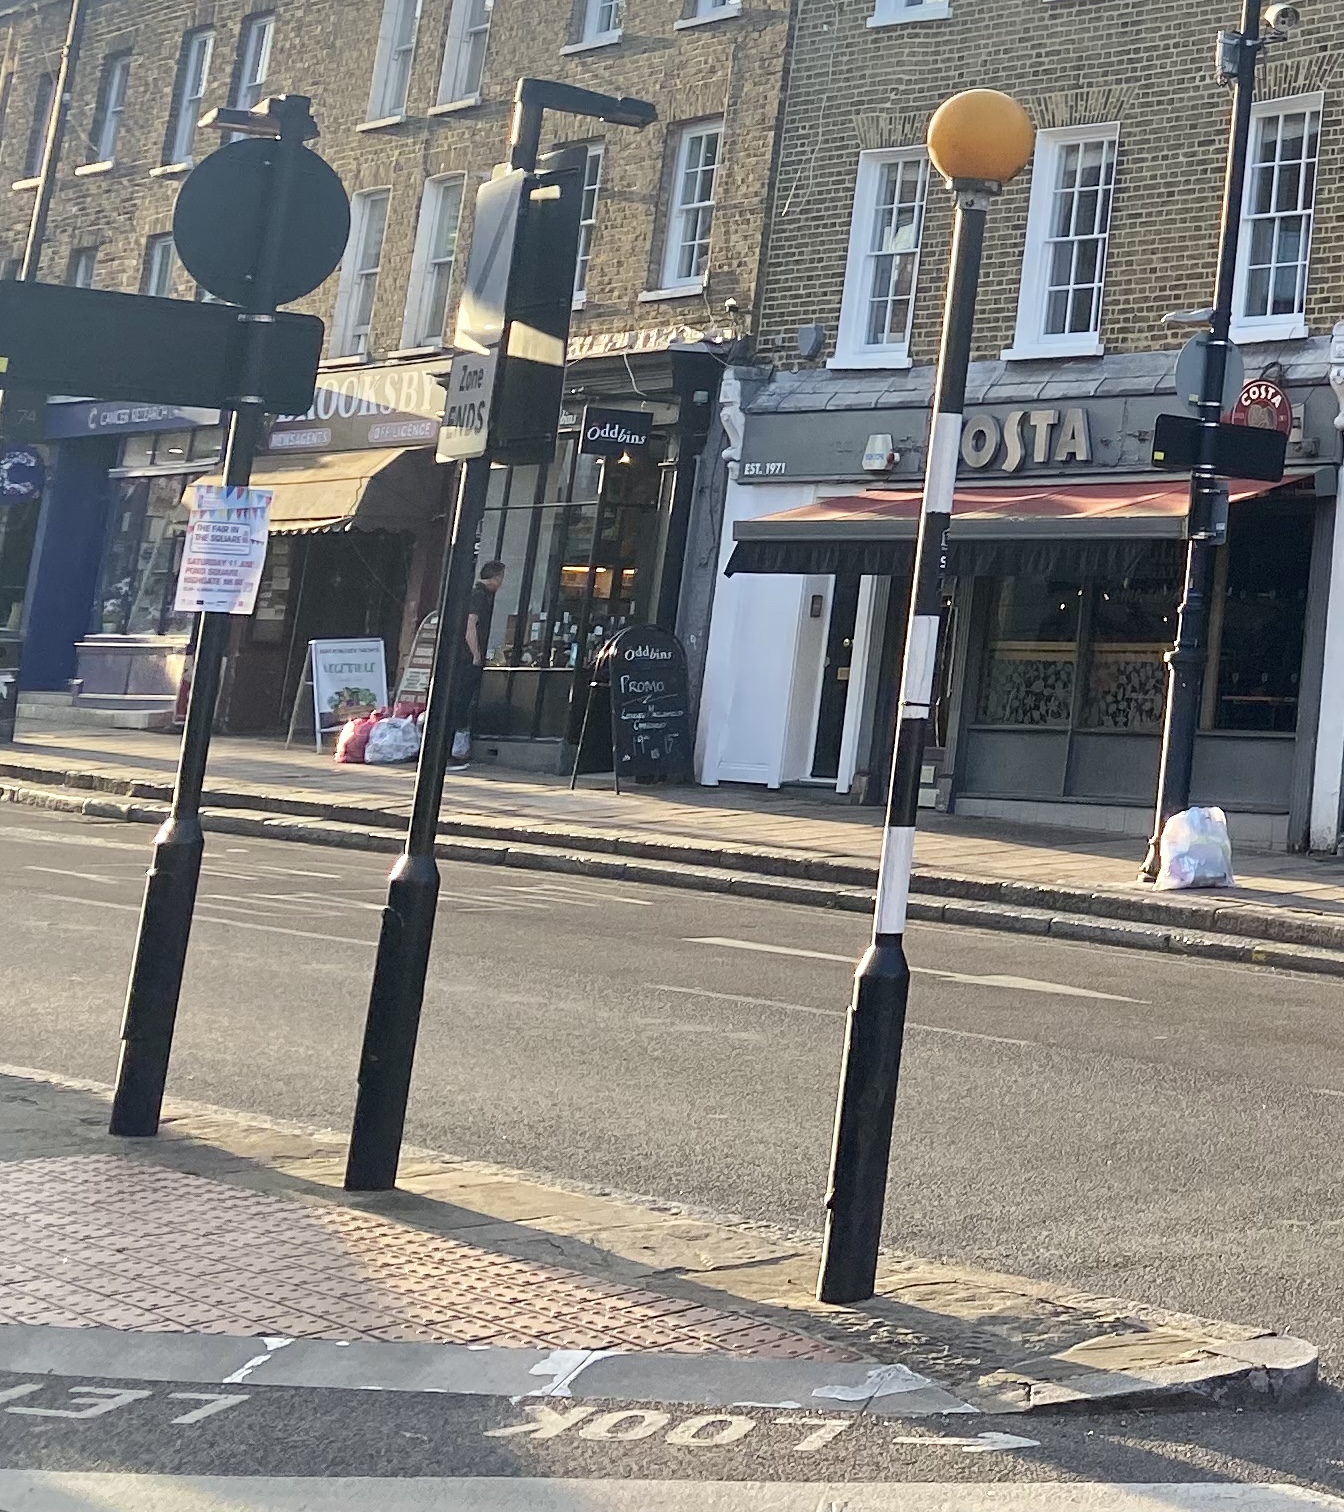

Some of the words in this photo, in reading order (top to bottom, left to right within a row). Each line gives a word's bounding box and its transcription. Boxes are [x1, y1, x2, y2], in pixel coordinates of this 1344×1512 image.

[459, 365, 484, 392] Zone
[276, 371, 438, 423] OOKSBY
[1241, 385, 1282, 408] COSTA
[448, 400, 486, 441] ENDS
[587, 423, 647, 445] Oddbins
[958, 407, 1093, 473] OSTA
[744, 463, 763, 476] EST.
[765, 462, 786, 475] 1971
[624, 645, 674, 661] Oddbins
[620, 674, 665, 694] PROMO
[483, 1405, 854, 1452] LOOK
